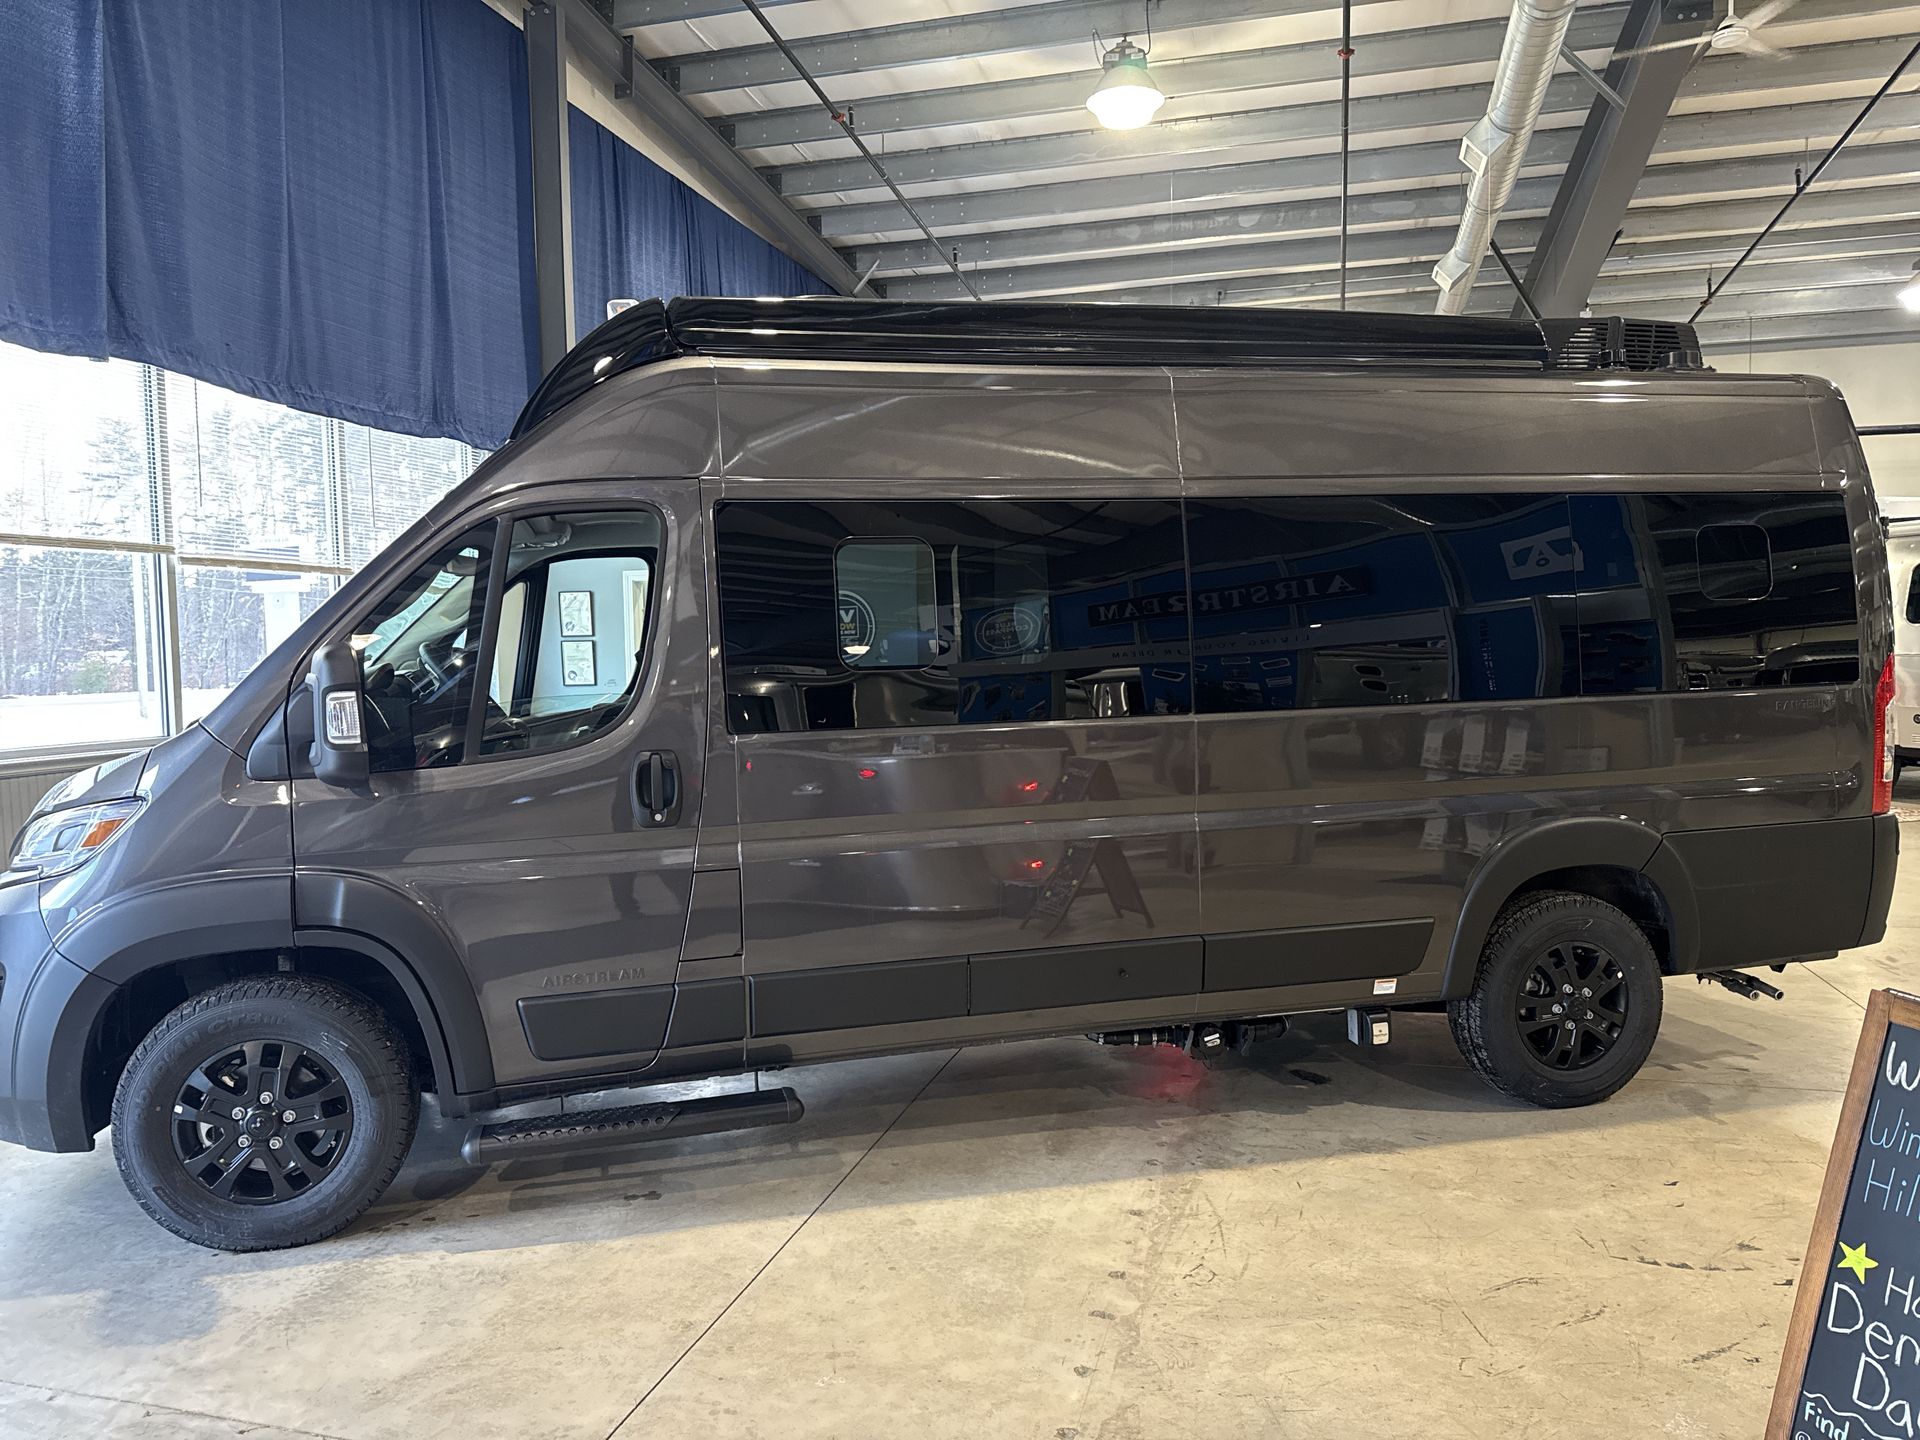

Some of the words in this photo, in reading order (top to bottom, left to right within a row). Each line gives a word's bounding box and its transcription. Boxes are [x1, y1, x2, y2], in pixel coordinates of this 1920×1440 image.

[1863, 1158, 1920, 1222] Hil
[1804, 1401, 1850, 1440] Find
[1852, 1352, 1920, 1439] Da
